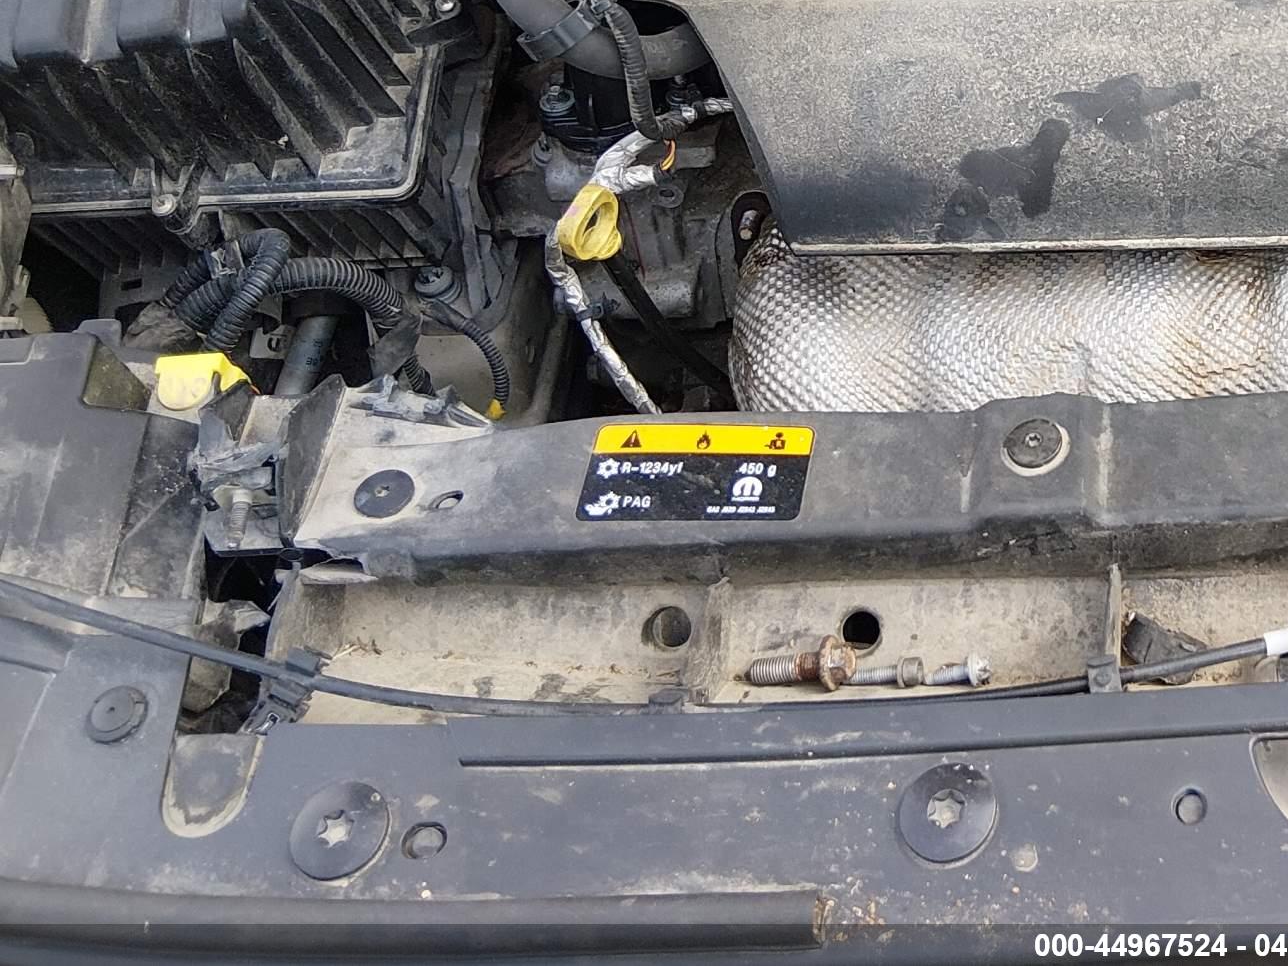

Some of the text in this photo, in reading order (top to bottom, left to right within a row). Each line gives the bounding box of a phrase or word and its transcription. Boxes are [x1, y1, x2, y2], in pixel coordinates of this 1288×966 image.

[620, 461, 777, 477] R-1234yf 450 g
[623, 495, 651, 508] PAG
